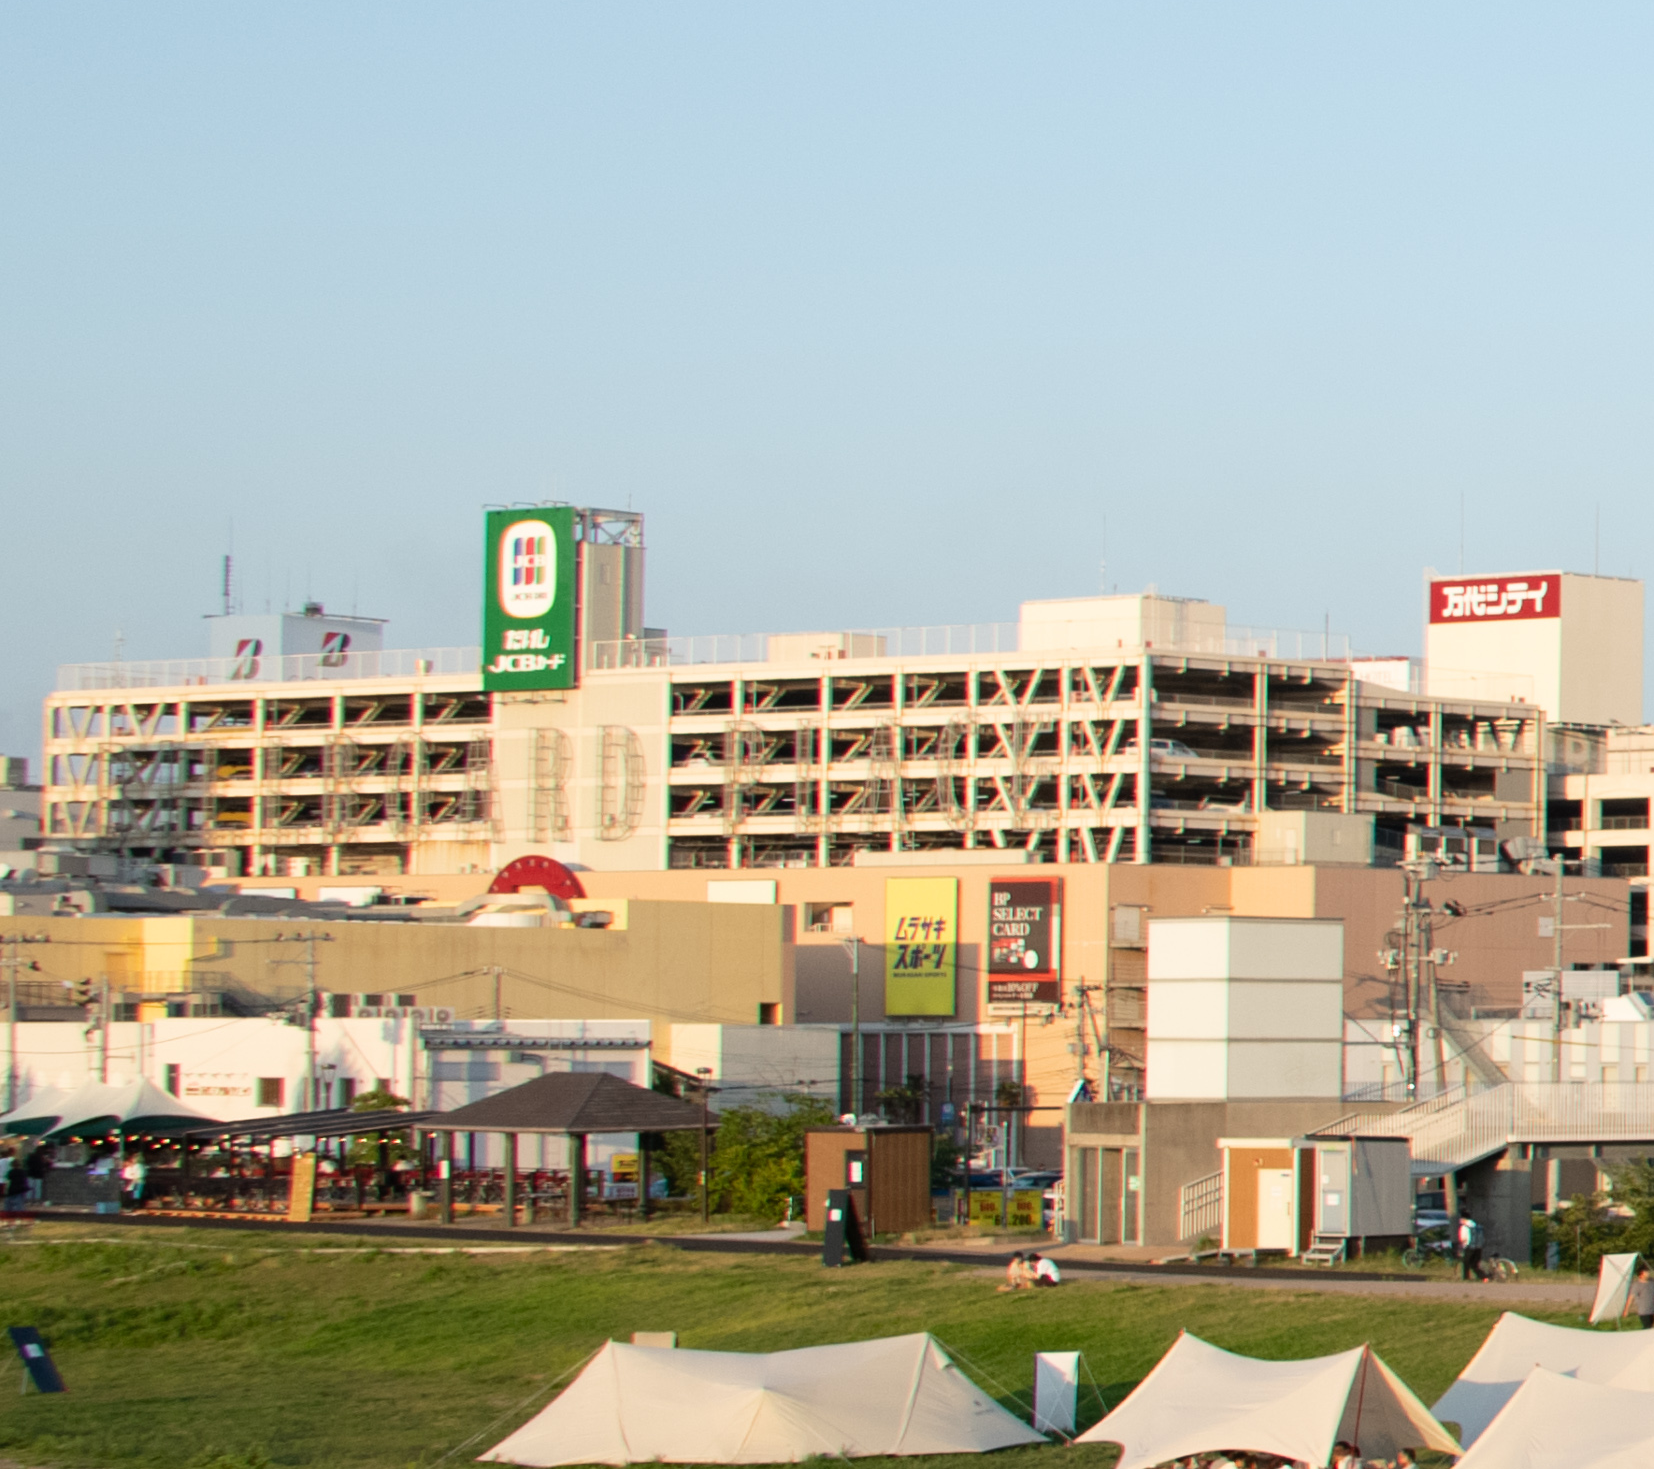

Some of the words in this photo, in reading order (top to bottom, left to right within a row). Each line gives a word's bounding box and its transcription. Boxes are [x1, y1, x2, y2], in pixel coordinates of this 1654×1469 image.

[992, 892, 1011, 906] BP
[992, 907, 1043, 921] SELECT
[894, 917, 947, 941] ムラサキ
[992, 923, 1031, 937] CARD
[893, 943, 947, 969] スポーツ
